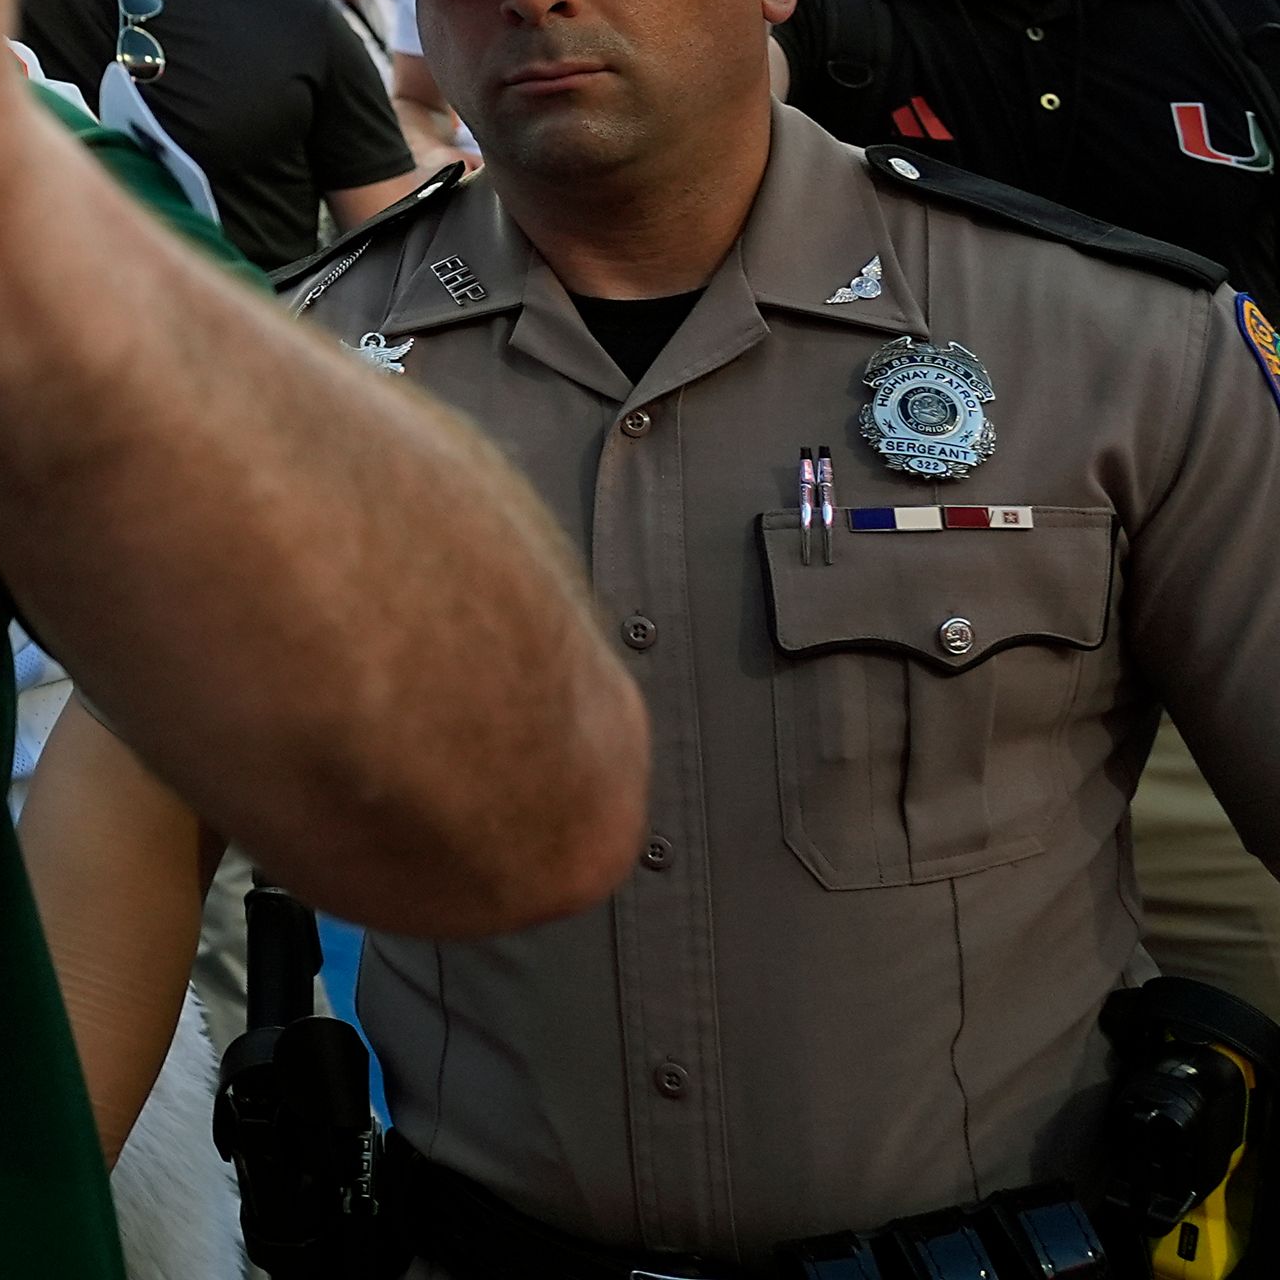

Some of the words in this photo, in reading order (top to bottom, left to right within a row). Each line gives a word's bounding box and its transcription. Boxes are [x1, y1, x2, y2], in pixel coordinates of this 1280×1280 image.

[1170, 102, 1275, 174] U
[430, 254, 487, 305] FHP
[891, 357, 910, 367] 85
[912, 355, 965, 376] YEARS
[877, 370, 930, 407] HIGHWAY
[934, 373, 979, 417] PATROL
[908, 419, 955, 432] FLORIDA
[885, 440, 970, 461] SERGEANT
[916, 460, 940, 471] 322
